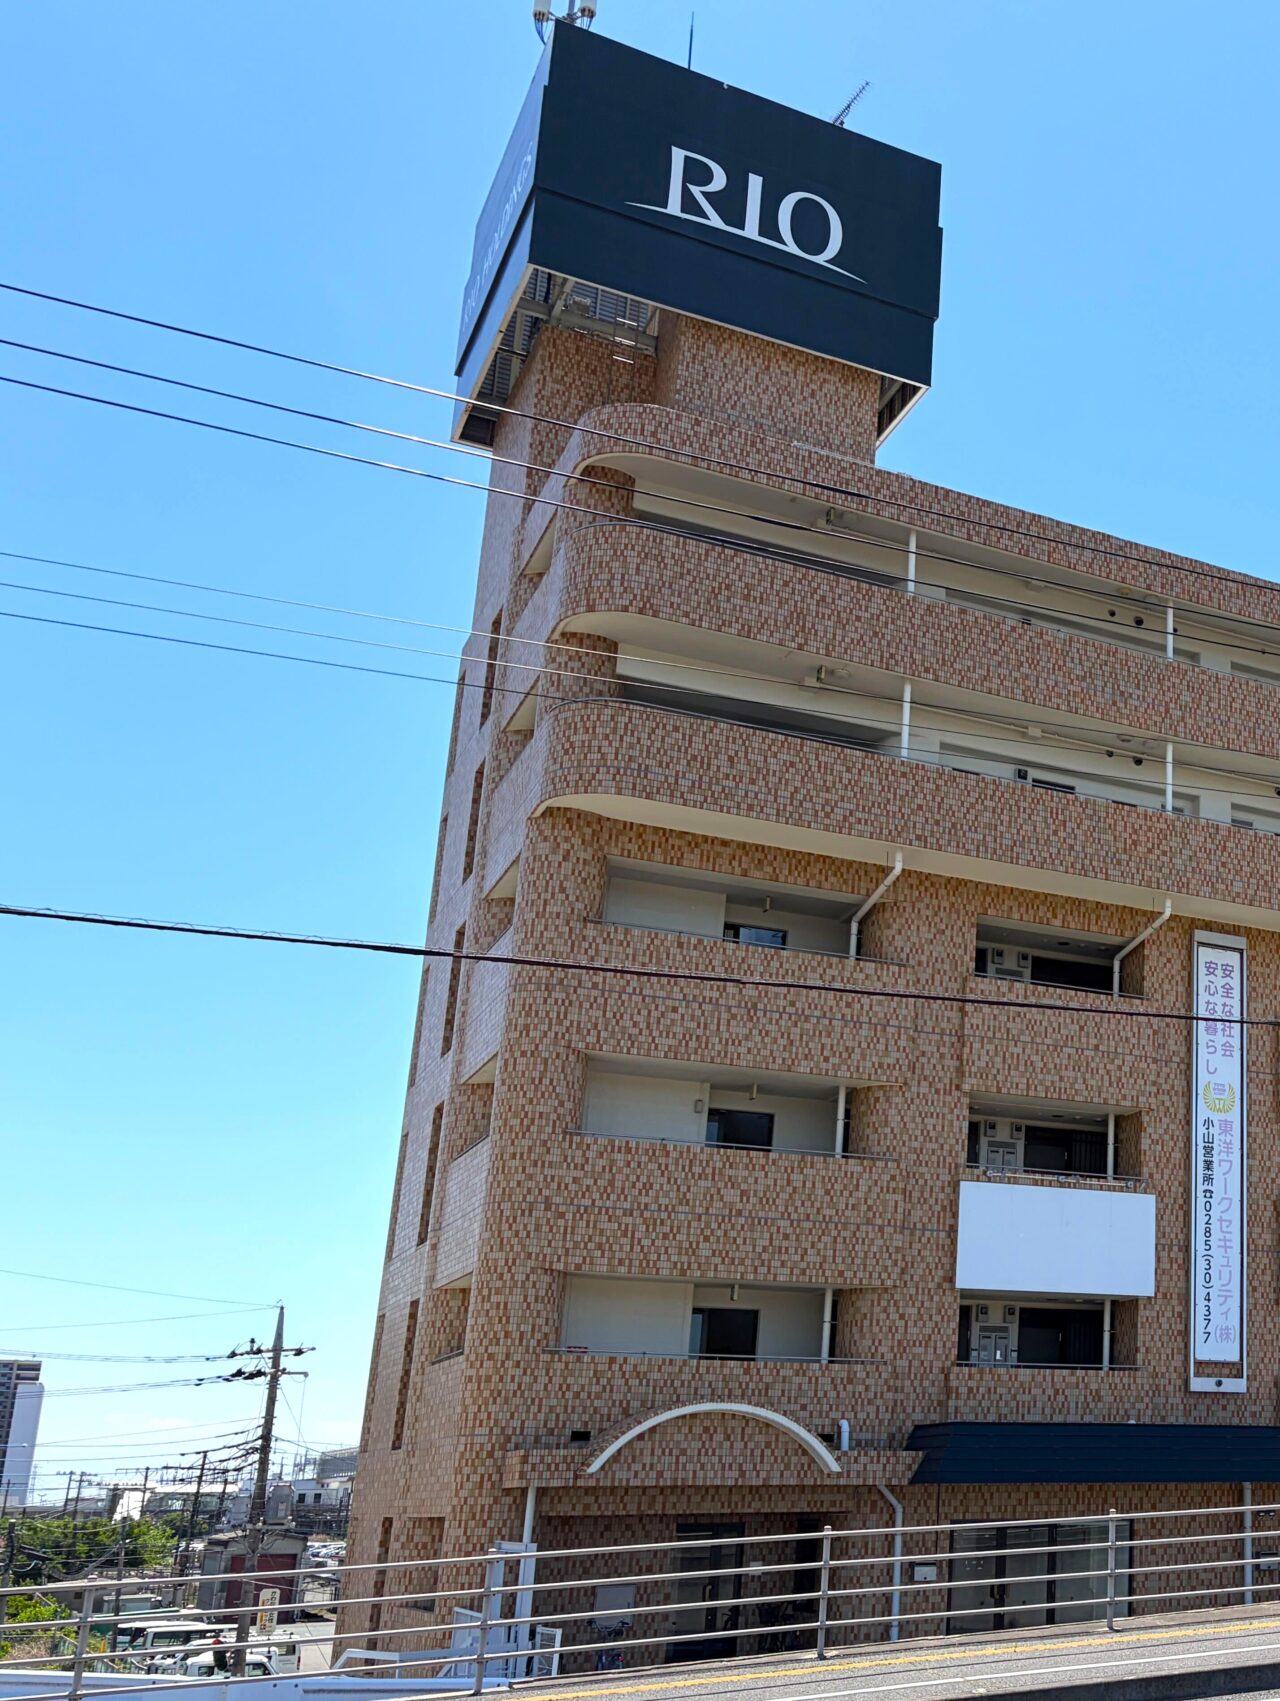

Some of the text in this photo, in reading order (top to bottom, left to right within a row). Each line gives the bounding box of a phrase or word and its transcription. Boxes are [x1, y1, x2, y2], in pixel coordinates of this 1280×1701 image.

[666, 145, 843, 262] RIO
[1203, 960, 1218, 1075] 安心な暮らし
[1220, 963, 1235, 1058] 安全な社会
[1202, 1116, 1215, 1187] 小山営業所
